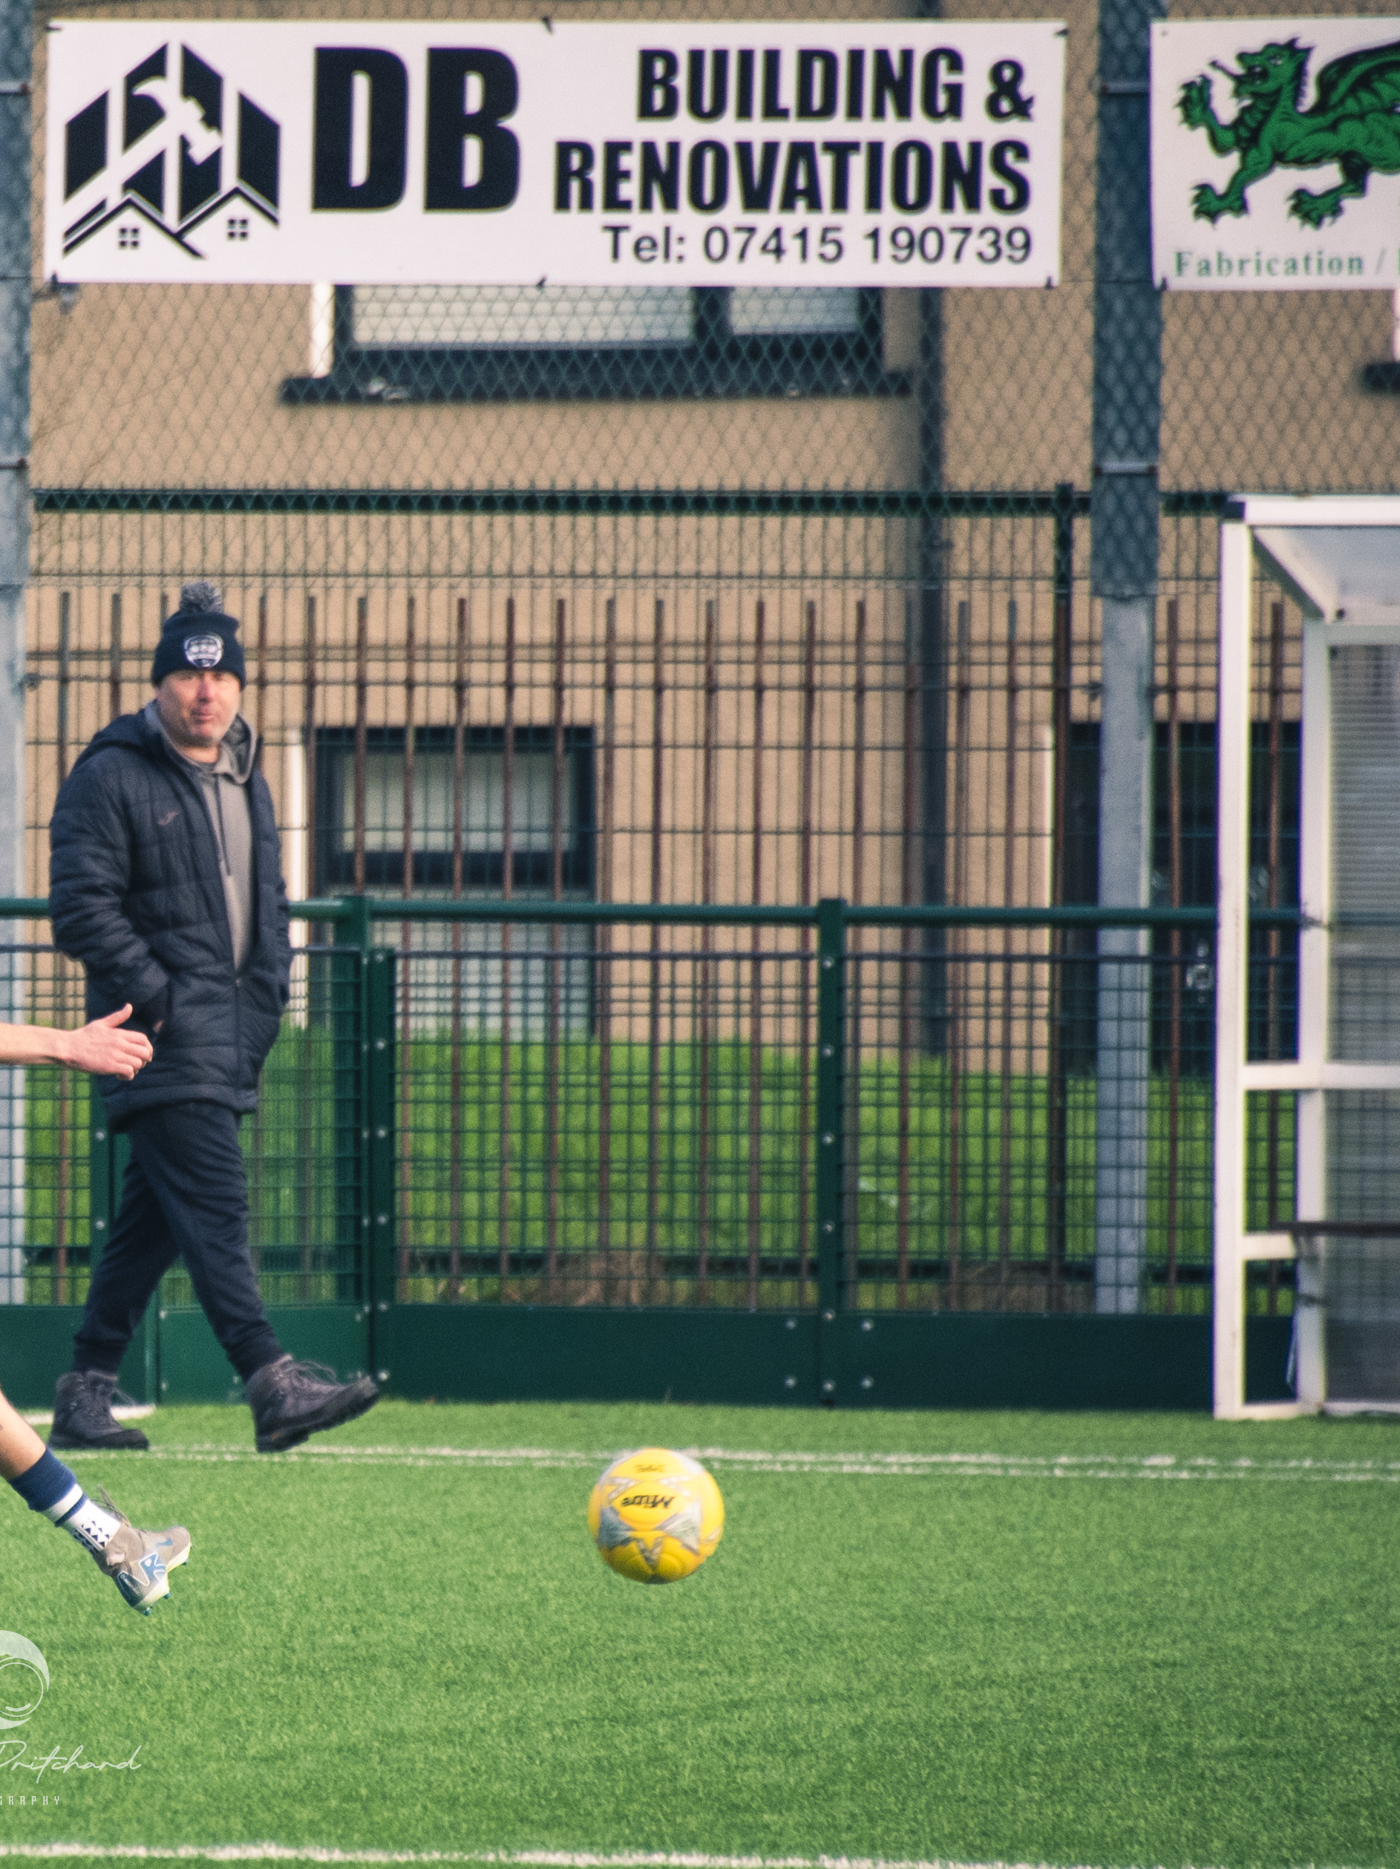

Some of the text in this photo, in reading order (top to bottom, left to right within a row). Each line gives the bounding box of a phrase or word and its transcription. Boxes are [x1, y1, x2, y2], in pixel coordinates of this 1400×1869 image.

[636, 48, 1035, 121] BUILDING &
[310, 46, 522, 214] DB
[553, 140, 1032, 214] RENOVATIONS
[602, 226, 1033, 264] Tel: 07415 190739
[1174, 250, 1364, 277] Fabrication
